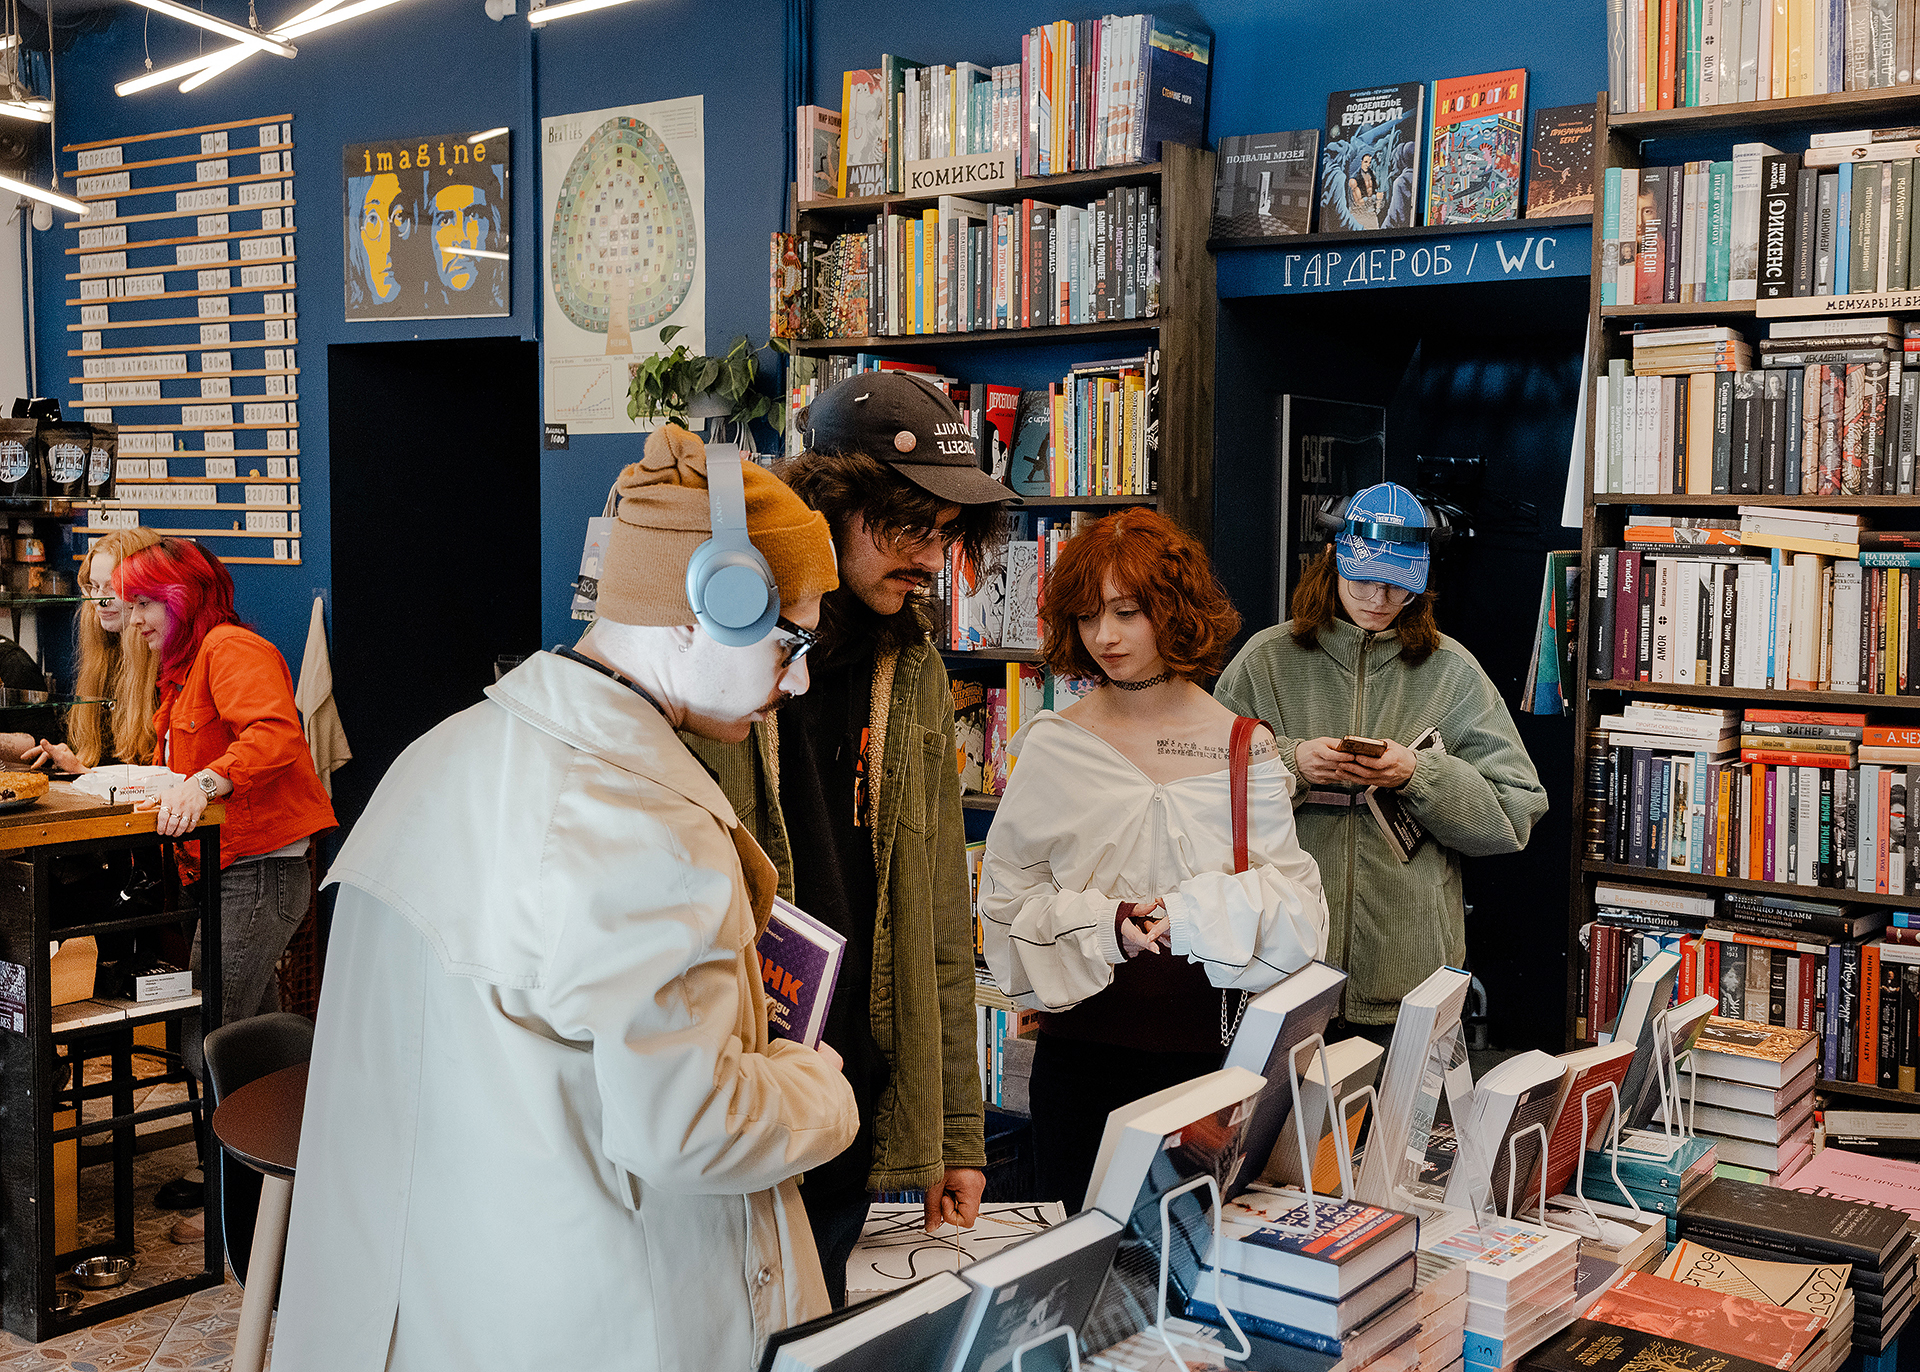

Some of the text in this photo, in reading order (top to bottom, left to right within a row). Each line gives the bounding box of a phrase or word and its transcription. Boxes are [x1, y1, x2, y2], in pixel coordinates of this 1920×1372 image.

[1855, 17, 1868, 80] ДНЕВНИК
[1881, 13, 1894, 75] ДНЕВНИК
[1703, 55, 1715, 83] AMOR
[1345, 98, 1402, 113] ПОДЗЕМЕЛЬЕ
[1441, 83, 1519, 115] НАОБОРОТИЯ
[1341, 107, 1404, 127] ВЕДЬМ
[261, 129, 278, 143] 180
[1559, 135, 1583, 145] БЕРЕГ
[79, 151, 121, 168] ЭСПРЕССО
[262, 157, 279, 171] 180
[363, 141, 487, 173] imagine
[1226, 152, 1272, 165] ПОДВАЛЫ
[1272, 149, 1306, 161] МУЗЕЯ
[78, 175, 129, 194] АМЕРИКАНО
[911, 161, 1005, 190] КОМИКСЫ
[241, 184, 280, 200] 195/260
[1896, 177, 1906, 221] МЕМУАРЫ
[200, 218, 227, 234] 200мл
[263, 212, 280, 227] 250
[1820, 208, 1832, 253] ЛЕРМОНТОВ
[924, 223, 933, 266] Родина
[948, 233, 956, 271] ИРМИНА
[1048, 227, 1057, 274] СТИГМАТЫ
[1096, 210, 1106, 281] БЫЛОЕ ГРЯДУЩЕЕ
[1126, 214, 1134, 292] СКВОЗЬ СНЕГ
[81, 242, 281, 270] КАПУЧИНО 200/280мл 235/300
[1283, 236, 1557, 287] ГАРДЕРОБ / WC
[82, 267, 282, 297] ЛАТТЕ УРБЕЧЕМ 350мл 300/330
[1139, 263, 1147, 291] СНЕГ
[82, 296, 283, 322] КАКАО 350мл 370
[1826, 297, 1902, 311] МЕМУАРЫ И
[83, 322, 284, 347] РАФ 350мл 350
[85, 363, 105, 375] КОФЕ
[202, 354, 230, 370] 280мл
[266, 352, 284, 366] 300
[1803, 352, 1849, 364] ДЕКАДЕНТЫ
[84, 378, 285, 400] КОФЕ МУМИ-МАМЫ 280мл 250
[183, 406, 232, 422] 280/350мл
[244, 404, 286, 421] 280/340
[156, 432, 286, 450] ЧАЙ 400мл 220
[550, 434, 566, 444] 1600
[150, 459, 286, 476] ЧАЙ 400мл 270
[1301, 434, 1335, 484] СВЕТ
[171, 487, 214, 501] МЕЛИССОЙ
[247, 487, 286, 503] 220/370
[247, 514, 287, 529] 220/350
[274, 542, 286, 557] 60
[1865, 553, 1906, 562] НА ПУТЯХ
[1872, 560, 1910, 568] СВОБОДЕ
[1622, 558, 1633, 594] Деррида
[1597, 589, 1608, 599] ЛЕ
[1721, 584, 1734, 675] Помоги мне, Господи!
[1656, 634, 1667, 661] AMOR
[1786, 726, 1824, 736] ВАГНЕР
[1886, 731, 1900, 743] А.
[1649, 770, 1662, 821] ОДУРАЧЕННЫЕ
[1820, 795, 1831, 864] ПРОЖИТЫЕ МЫСЛИ
[1848, 802, 1857, 848] ШАЛАМОВ
[1649, 898, 1685, 909] ЕРОФЕЕВ
[1734, 902, 1813, 920] ПАЛАЦЦО МАДАМЫ
[1830, 1170, 1870, 1183] Flyers
[1806, 1266, 1849, 1316] 1922
